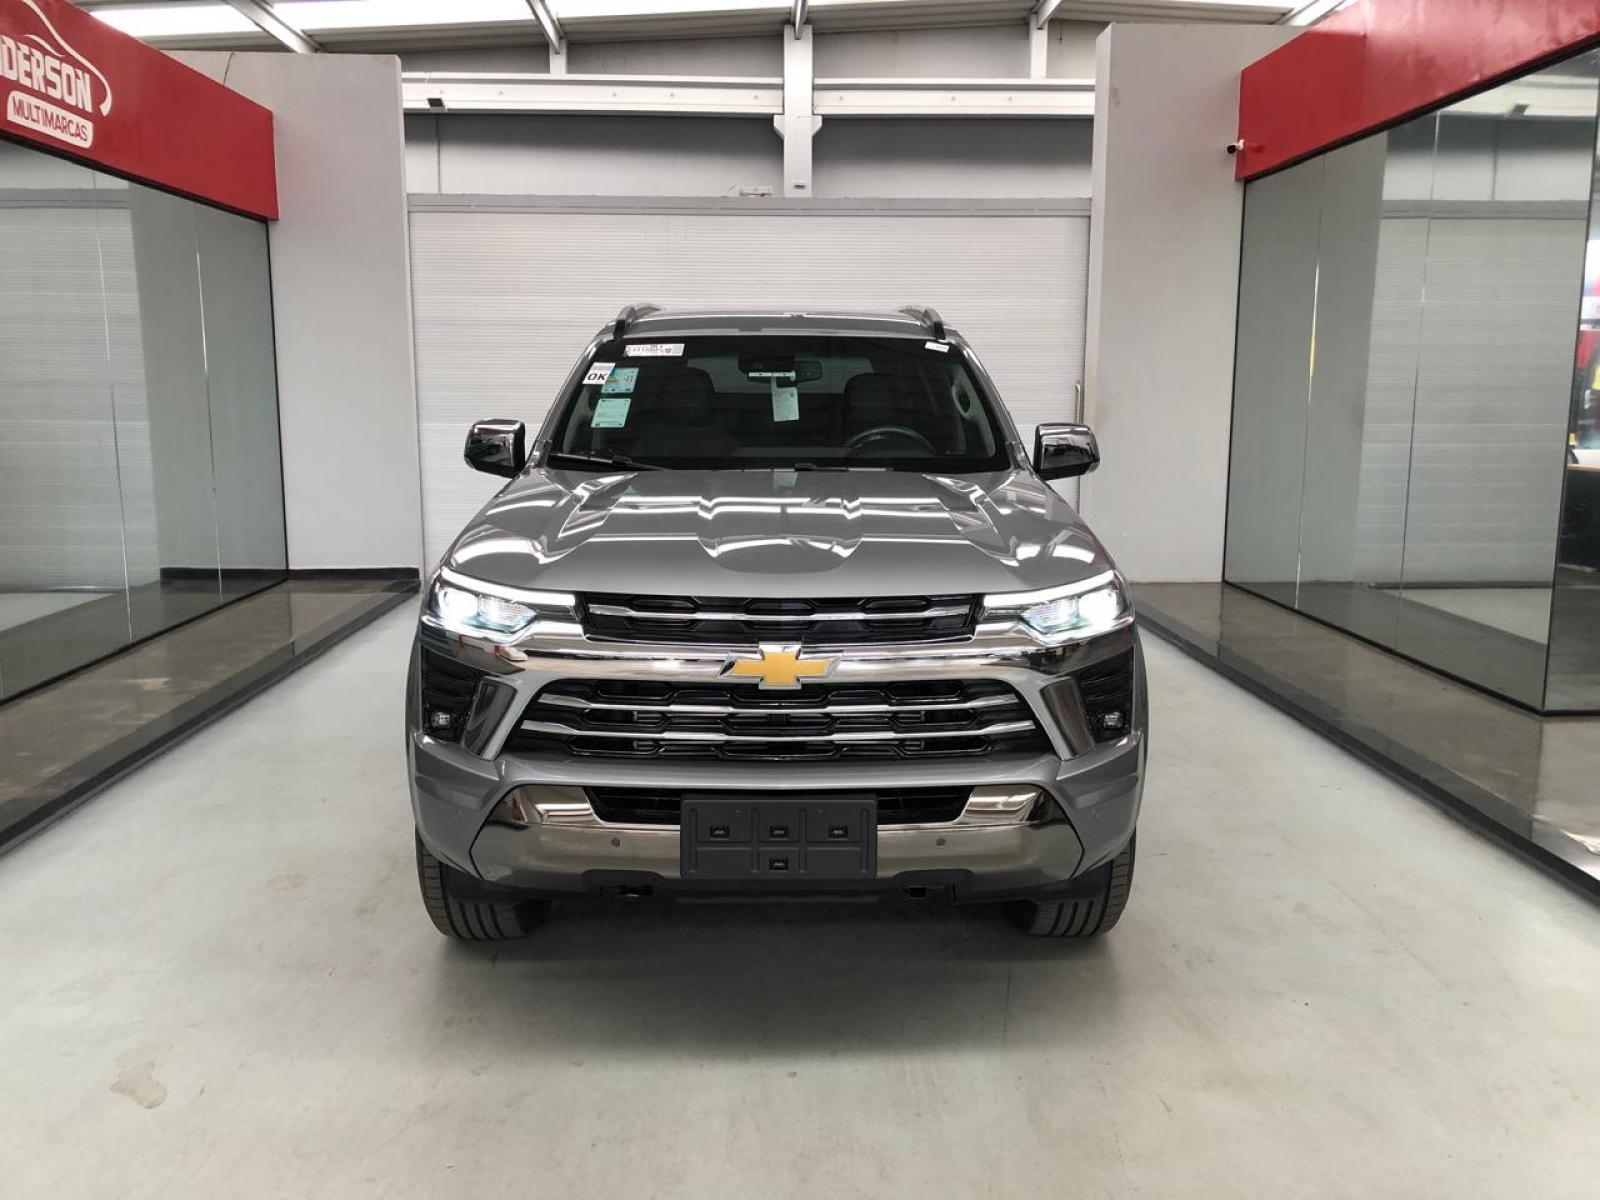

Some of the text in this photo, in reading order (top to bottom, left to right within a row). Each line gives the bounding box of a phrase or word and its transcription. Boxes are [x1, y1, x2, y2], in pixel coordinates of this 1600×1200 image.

[0, 34, 93, 113] DERSON
[12, 96, 88, 142] MULTIMARCAS
[587, 373, 607, 381] OK
